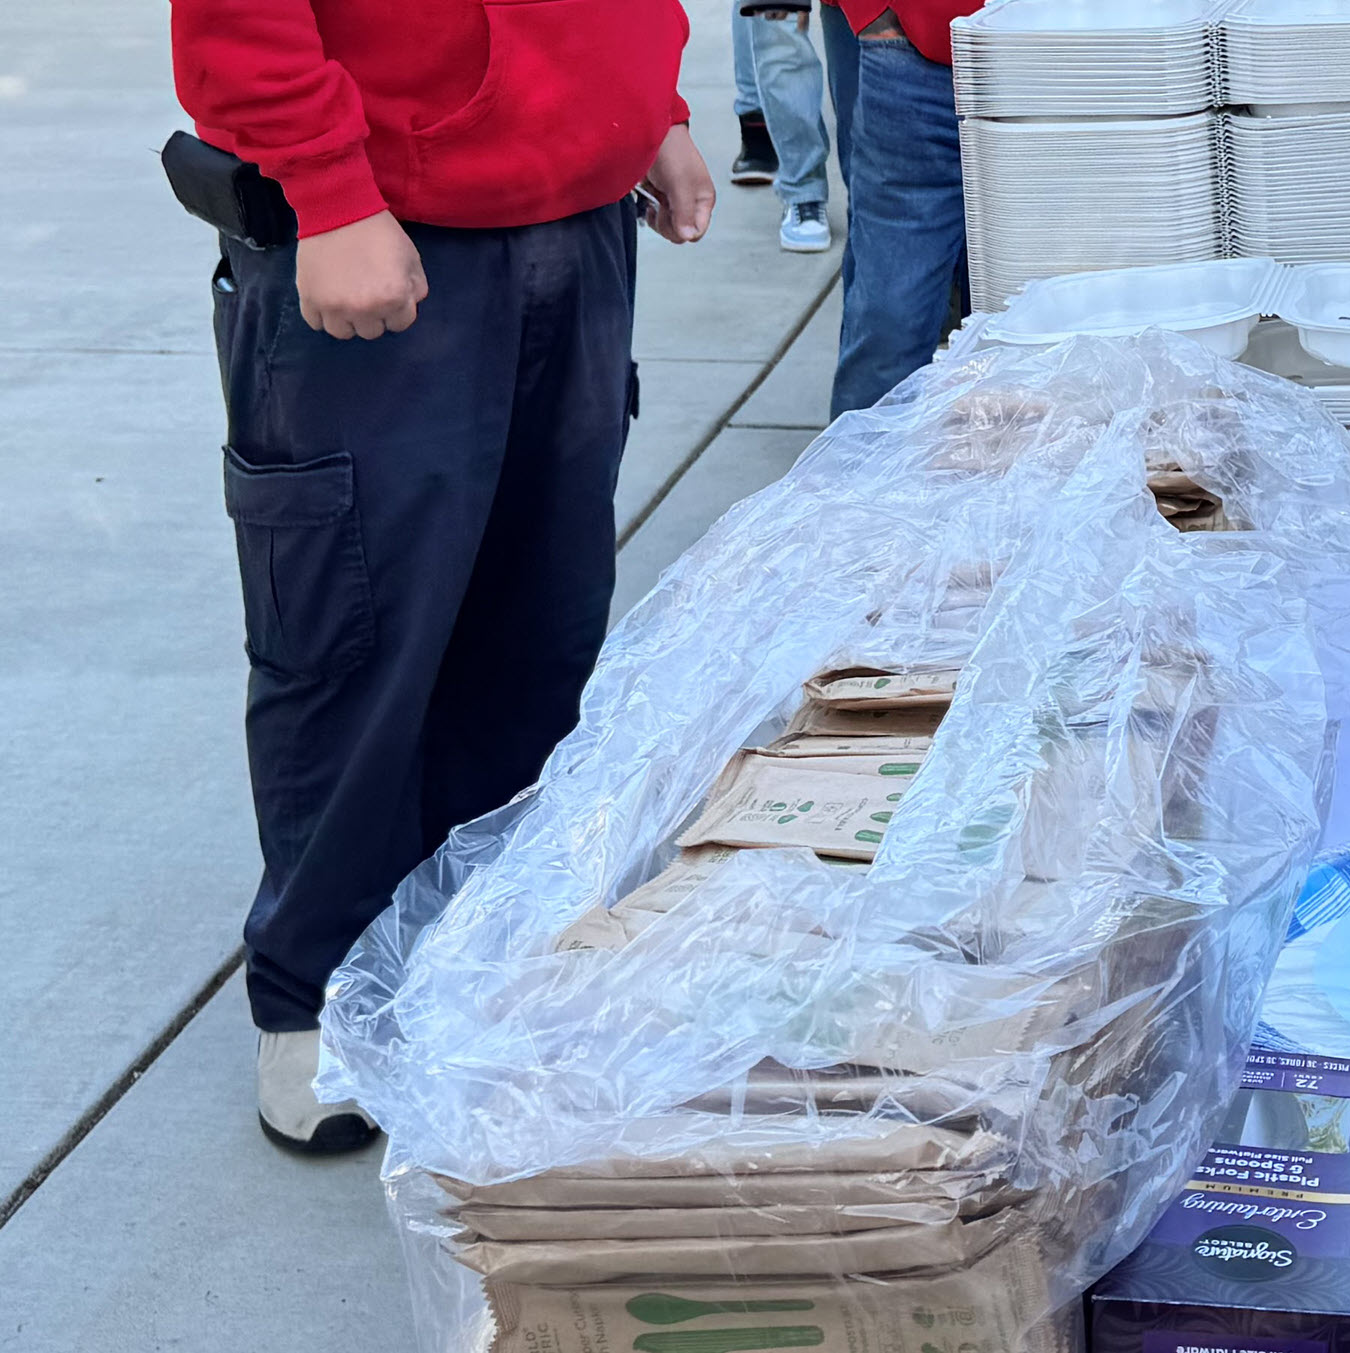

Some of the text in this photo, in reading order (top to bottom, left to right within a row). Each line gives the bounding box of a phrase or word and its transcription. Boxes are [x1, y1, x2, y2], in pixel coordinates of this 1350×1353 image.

[1295, 1080, 1319, 1090] 72
[1264, 1152, 1289, 1162] Size
[1290, 1156, 1313, 1164] Full
[1214, 1156, 1304, 1175] & Spoons
[1196, 1165, 1320, 1187] Plastic Forks
[1205, 1183, 1304, 1199] PREMIUM
[1180, 1192, 1327, 1230] Entertaining
[1202, 1239, 1253, 1248] SELECT
[1195, 1242, 1293, 1267] Signature
